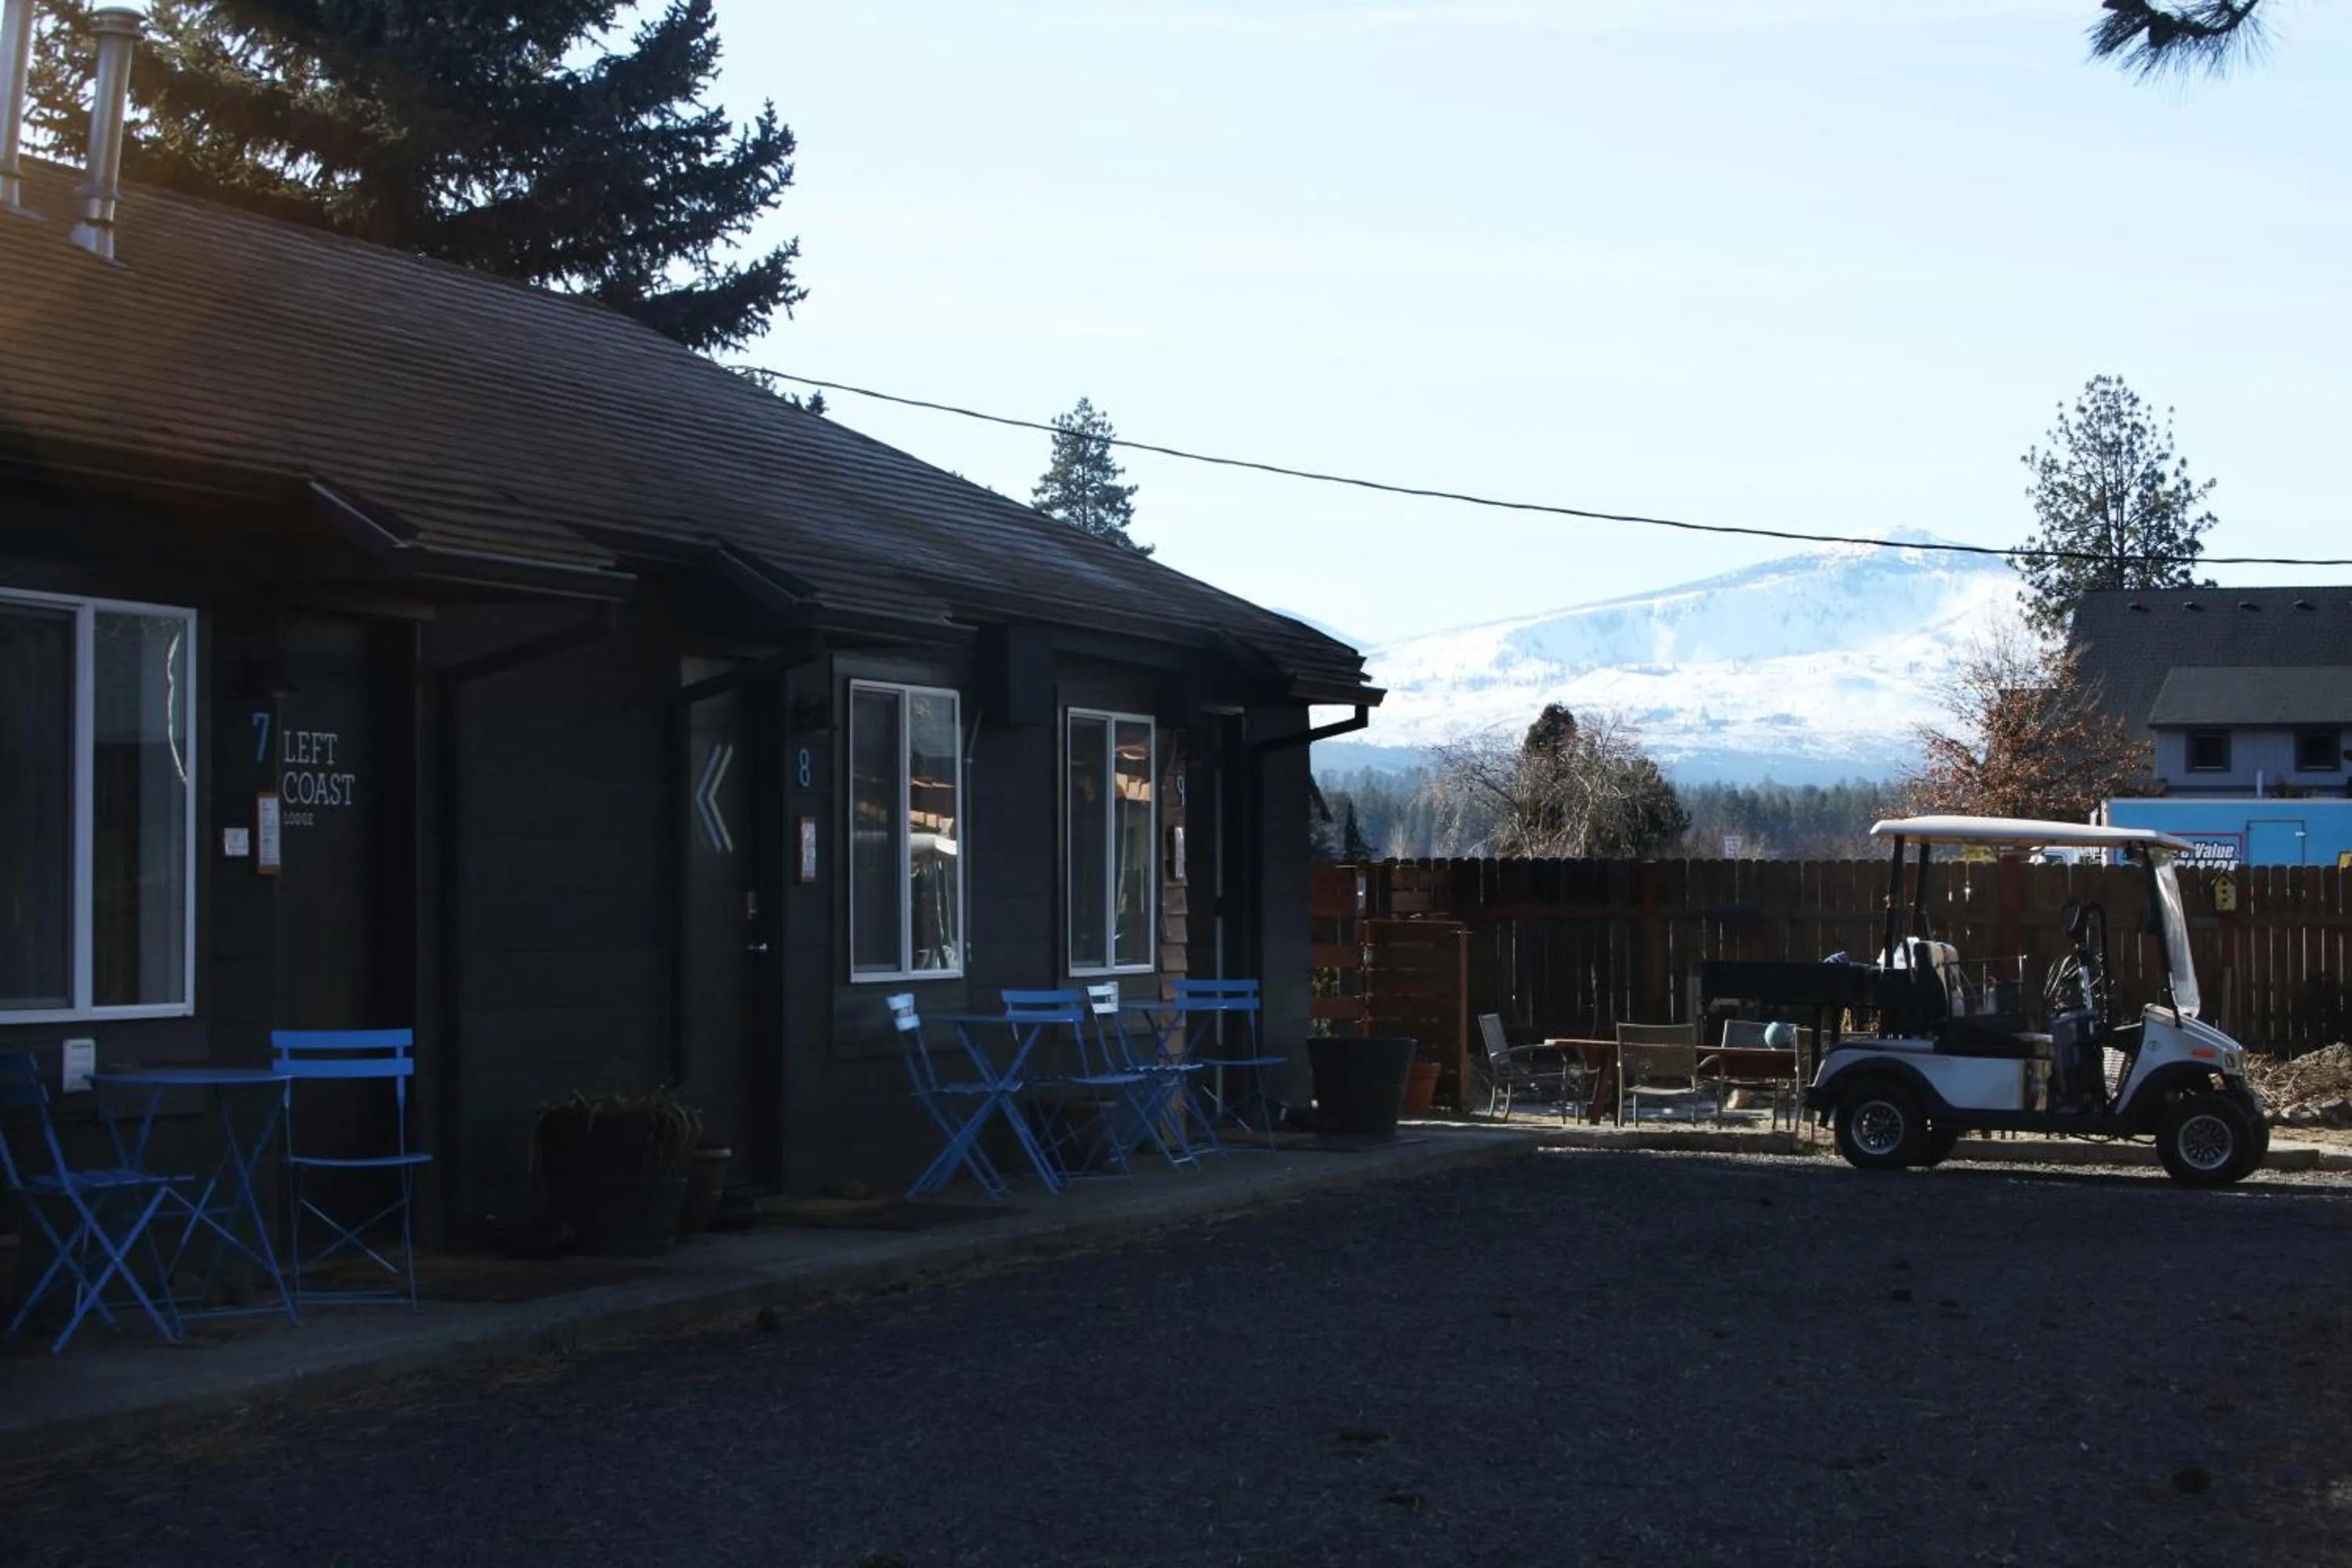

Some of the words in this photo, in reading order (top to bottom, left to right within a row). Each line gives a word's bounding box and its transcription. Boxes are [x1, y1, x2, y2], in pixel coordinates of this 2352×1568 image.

[251, 711, 271, 764] 7
[282, 730, 339, 765] LEFT
[798, 747, 811, 788] 8
[282, 771, 355, 806] COAST
[2194, 842, 2234, 858] Value
